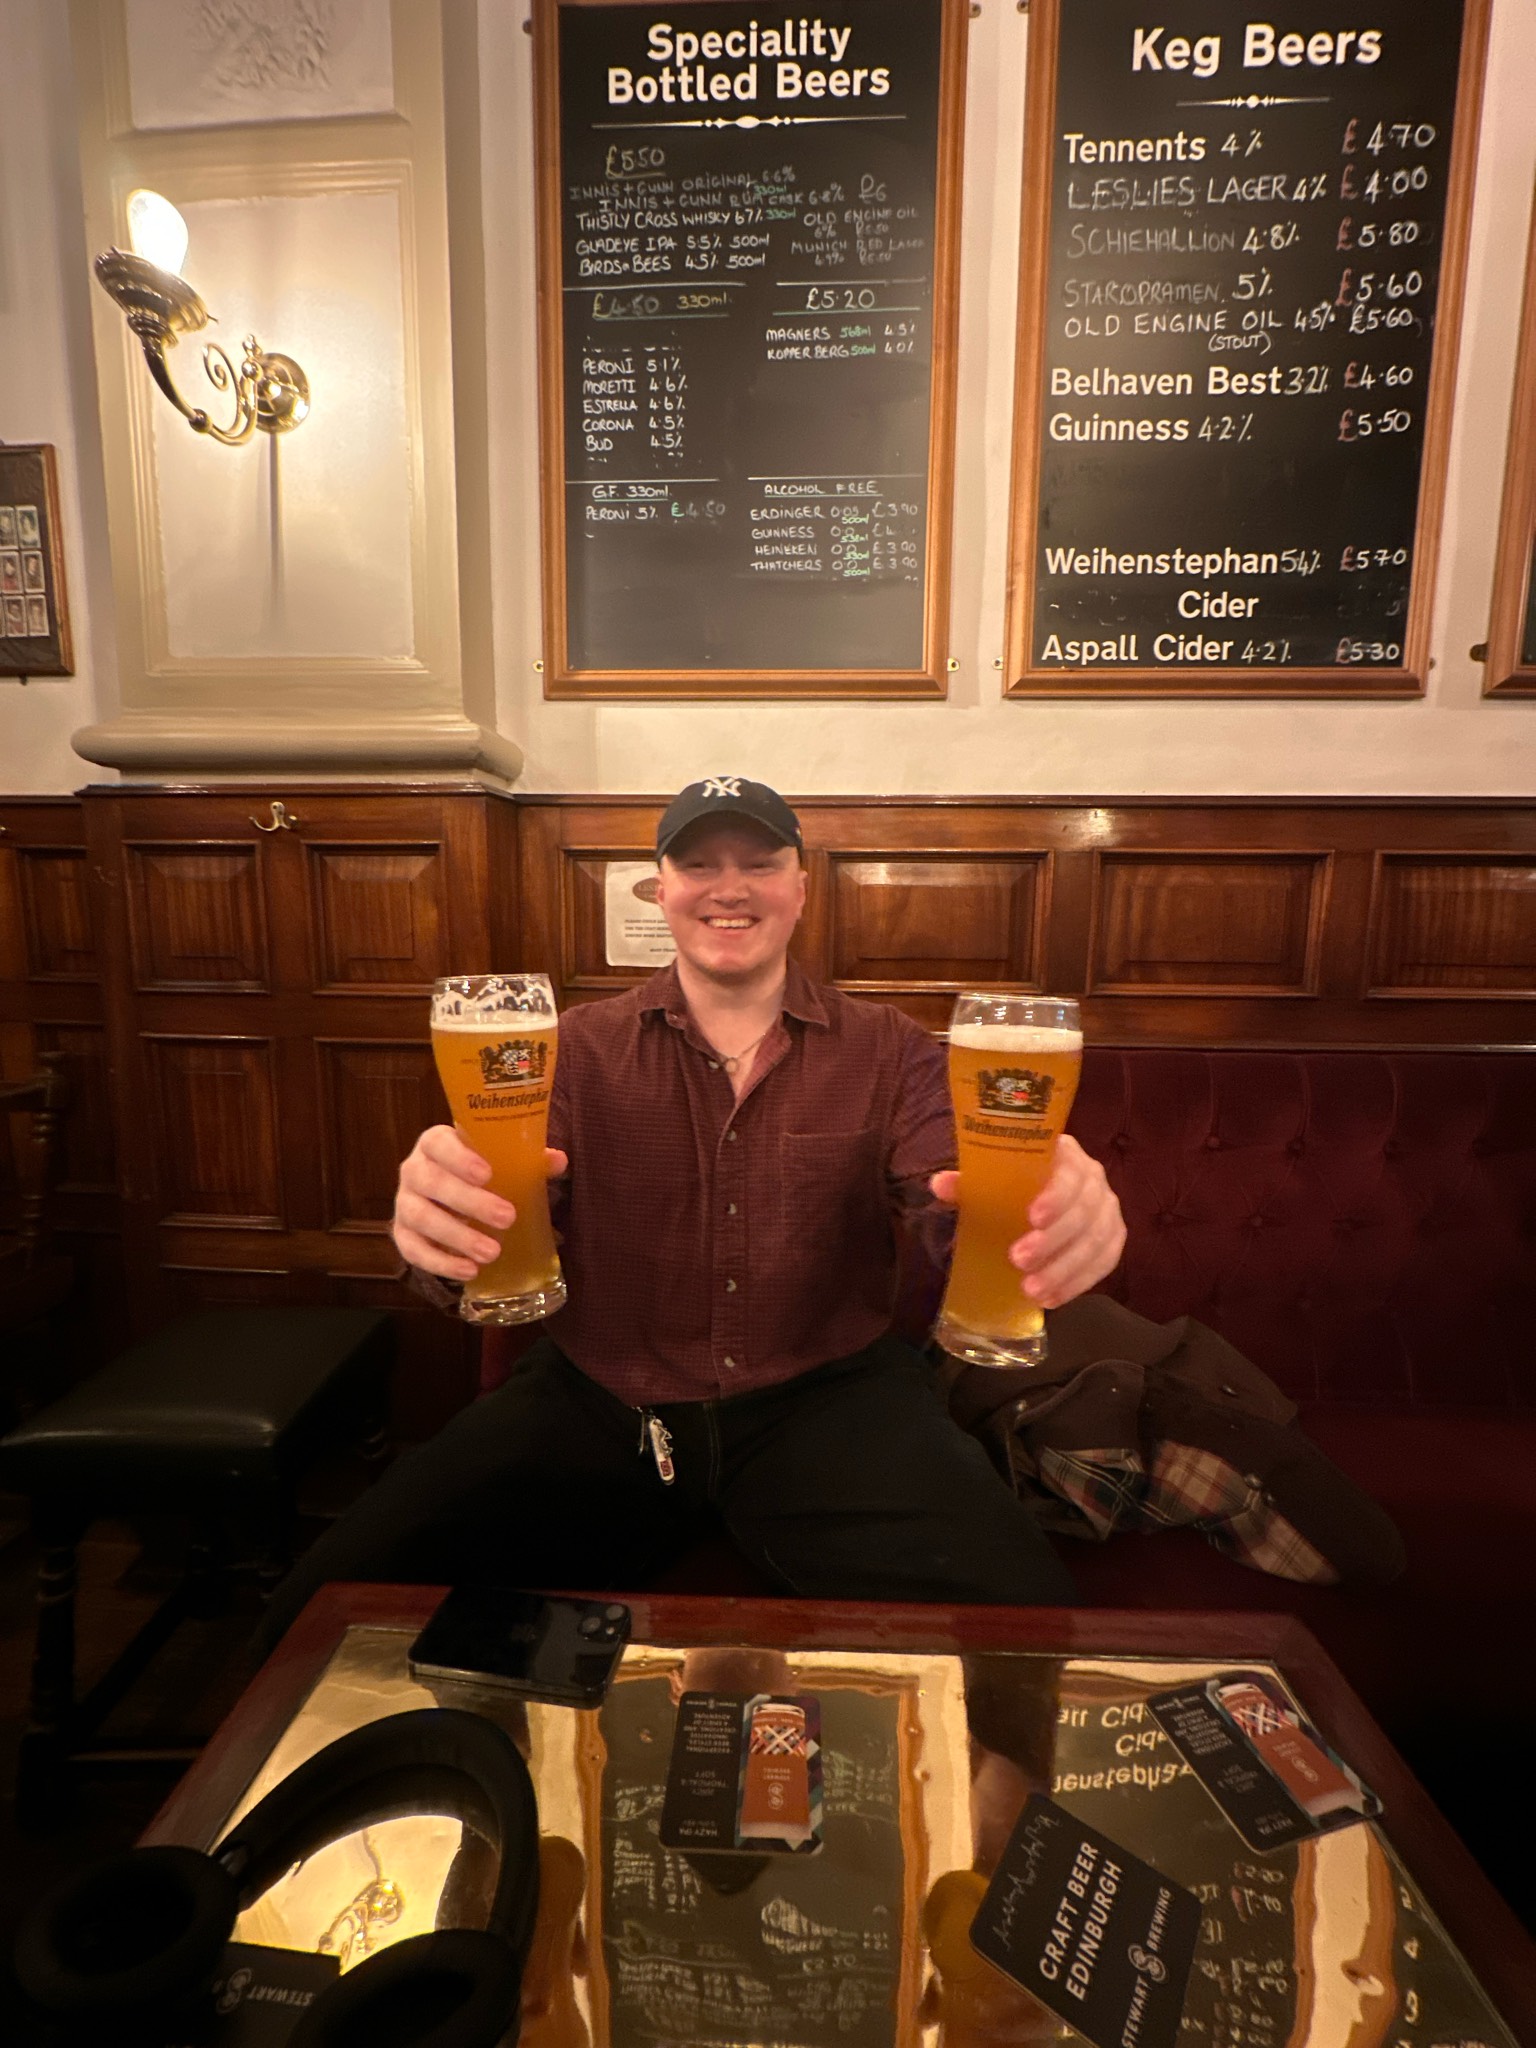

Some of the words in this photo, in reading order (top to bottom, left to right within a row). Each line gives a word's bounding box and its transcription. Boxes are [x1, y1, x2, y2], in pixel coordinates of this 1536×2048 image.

[647, 19, 851, 66] Speciality
[1131, 27, 1221, 77] Keg
[1242, 23, 1382, 68] Beers
[608, 64, 757, 104] Bottled
[777, 63, 890, 99] Beers
[1063, 131, 1206, 164] Tennents
[569, 183, 620, 200] INNIS
[682, 171, 757, 191] ORIGINAL
[1067, 176, 1196, 211] LESLIES
[1206, 173, 1287, 203] LAGER
[599, 196, 657, 213] INNIS
[576, 212, 629, 231] THISTLY
[634, 212, 678, 229] CROSS
[682, 213, 730, 225] WHISKY
[803, 211, 836, 226] OLD
[645, 238, 677, 252] IPA
[1066, 223, 1235, 258] SCHIEHALLION
[578, 259, 622, 277] BIRDS
[632, 255, 672, 273] BEES
[766, 327, 831, 342] MAGNERS
[1064, 314, 1120, 338] OLD
[1134, 310, 1228, 335] ENGINE
[1241, 308, 1283, 333] OIL
[1207, 330, 1272, 355] (STOUT)
[582, 358, 636, 375] PERONI
[582, 379, 637, 394] MORETTI
[1050, 367, 1193, 396] Belhaven
[1207, 365, 1282, 396] Best
[583, 398, 638, 414] ESTRELLA
[582, 418, 634, 432] CORONA
[1049, 412, 1190, 442] Guinness
[585, 436, 614, 452] BUD
[764, 483, 826, 495] ALCOHOL
[836, 481, 878, 494] FREE
[750, 505, 826, 521] ERDINGER
[751, 526, 815, 540] GUINNESS
[755, 544, 817, 556] HEINEKEN
[750, 559, 822, 571] THATCHERS
[1045, 546, 1278, 579] Weihenstephan
[1177, 589, 1259, 619] Cider
[1041, 633, 1139, 665] Aspall
[1153, 631, 1235, 661] Cider
[702, 777, 742, 797] NY
[1039, 1897, 1084, 1981] CRAFT
[1067, 1841, 1100, 1898] BEER
[1065, 1862, 1124, 2001] EDINBURGH
[1121, 1978, 1152, 2048] STEWART
[1146, 1887, 1172, 1953] BREWING
